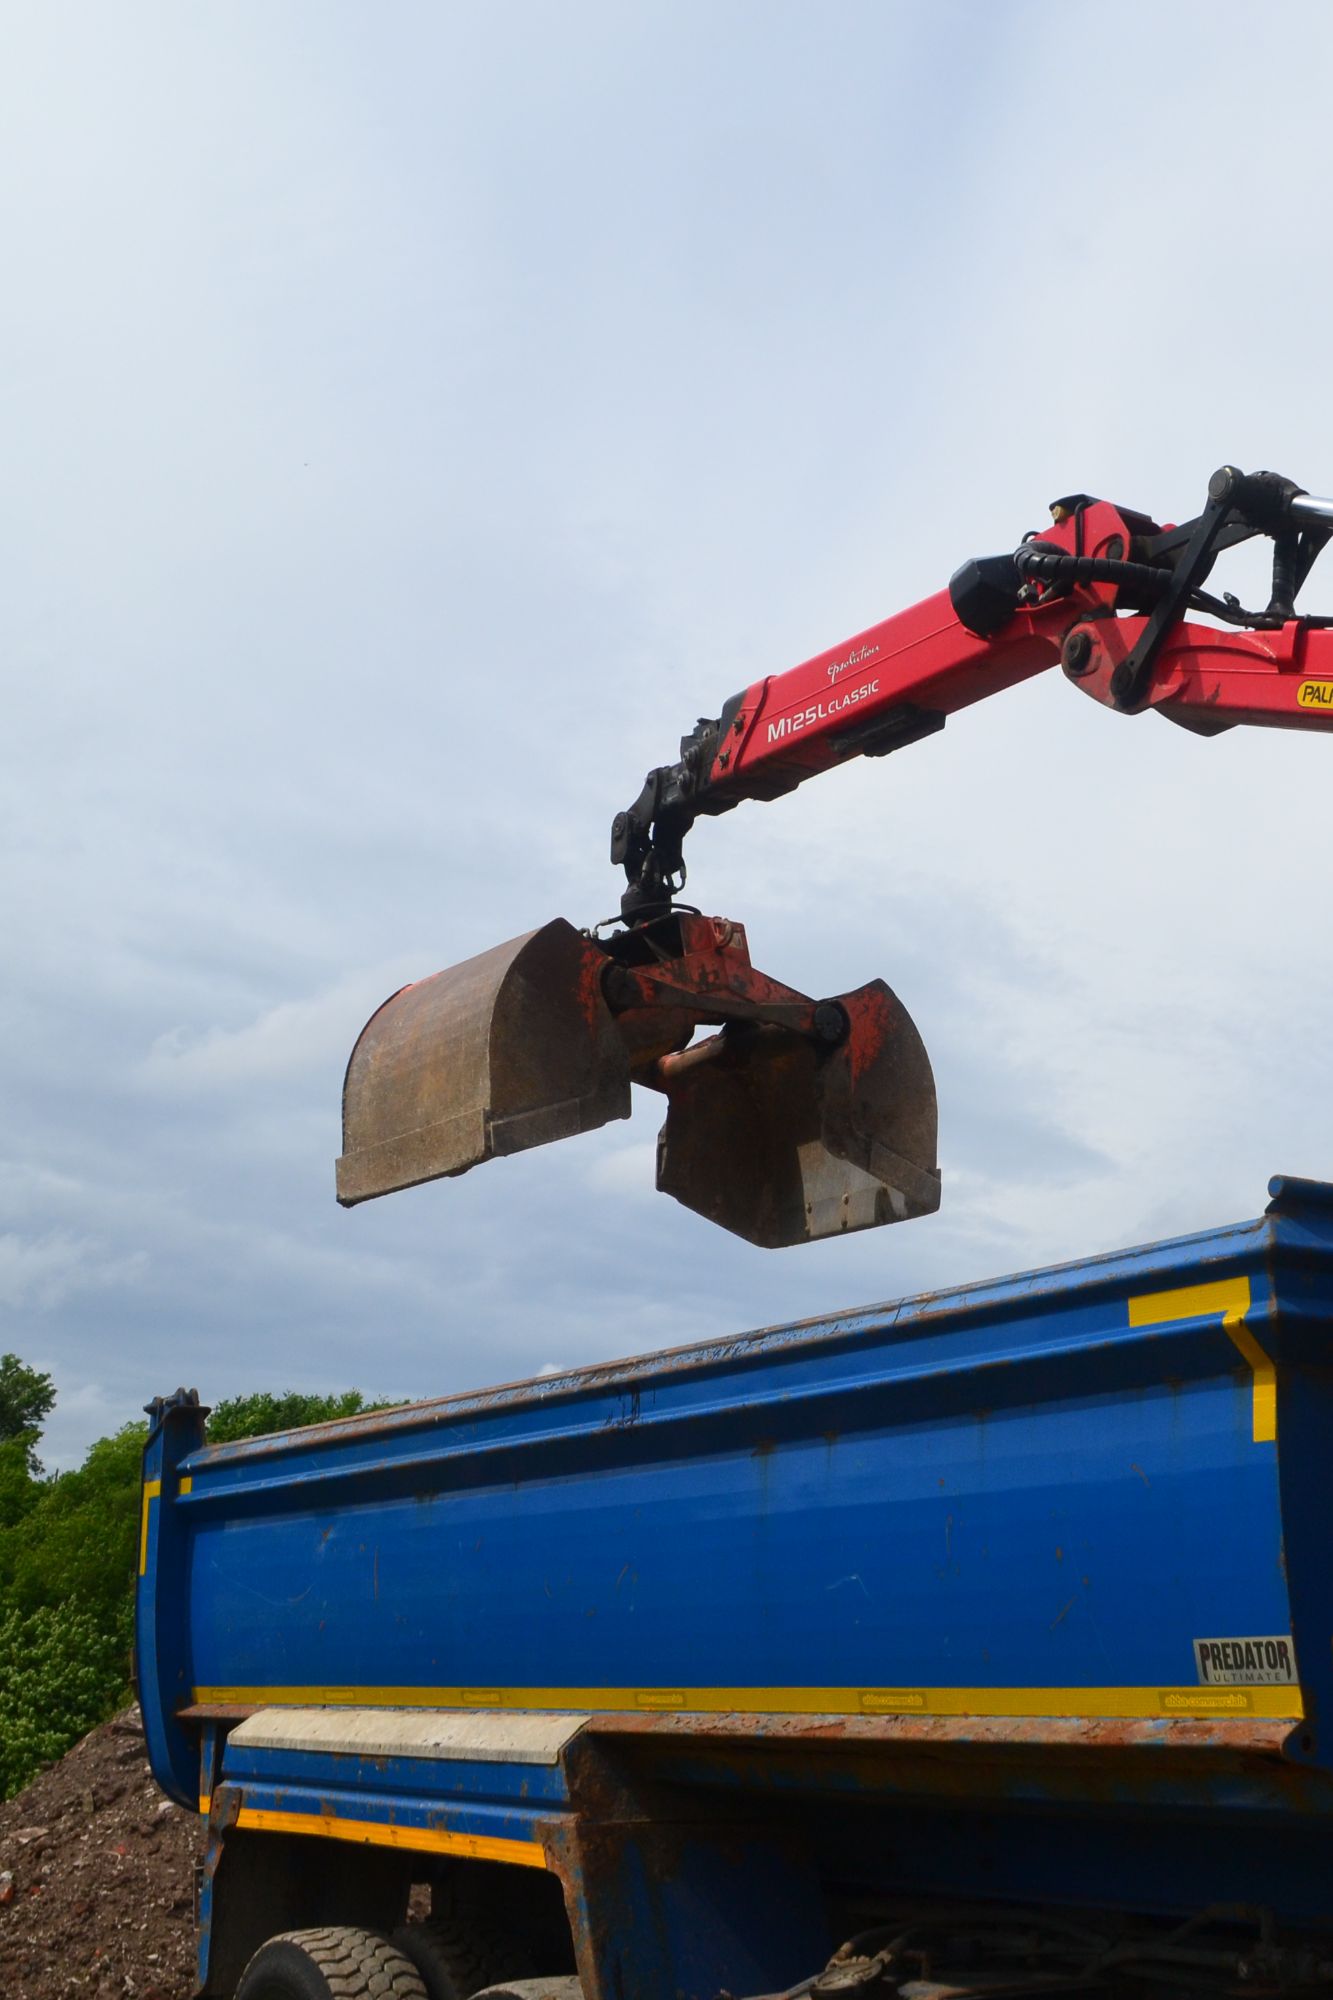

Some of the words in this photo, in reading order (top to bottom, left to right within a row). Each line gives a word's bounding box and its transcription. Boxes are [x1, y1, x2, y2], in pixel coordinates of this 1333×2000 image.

[827, 645, 880, 683] Epsolution
[767, 703, 827, 743] M125L
[828, 679, 880, 714] CLASSIC
[1198, 1640, 1292, 1682] PREDATOR
[1213, 1672, 1282, 1683] ULTIMATE
[1166, 1695, 1188, 1707] abba
[1189, 1695, 1247, 1707] commercials
